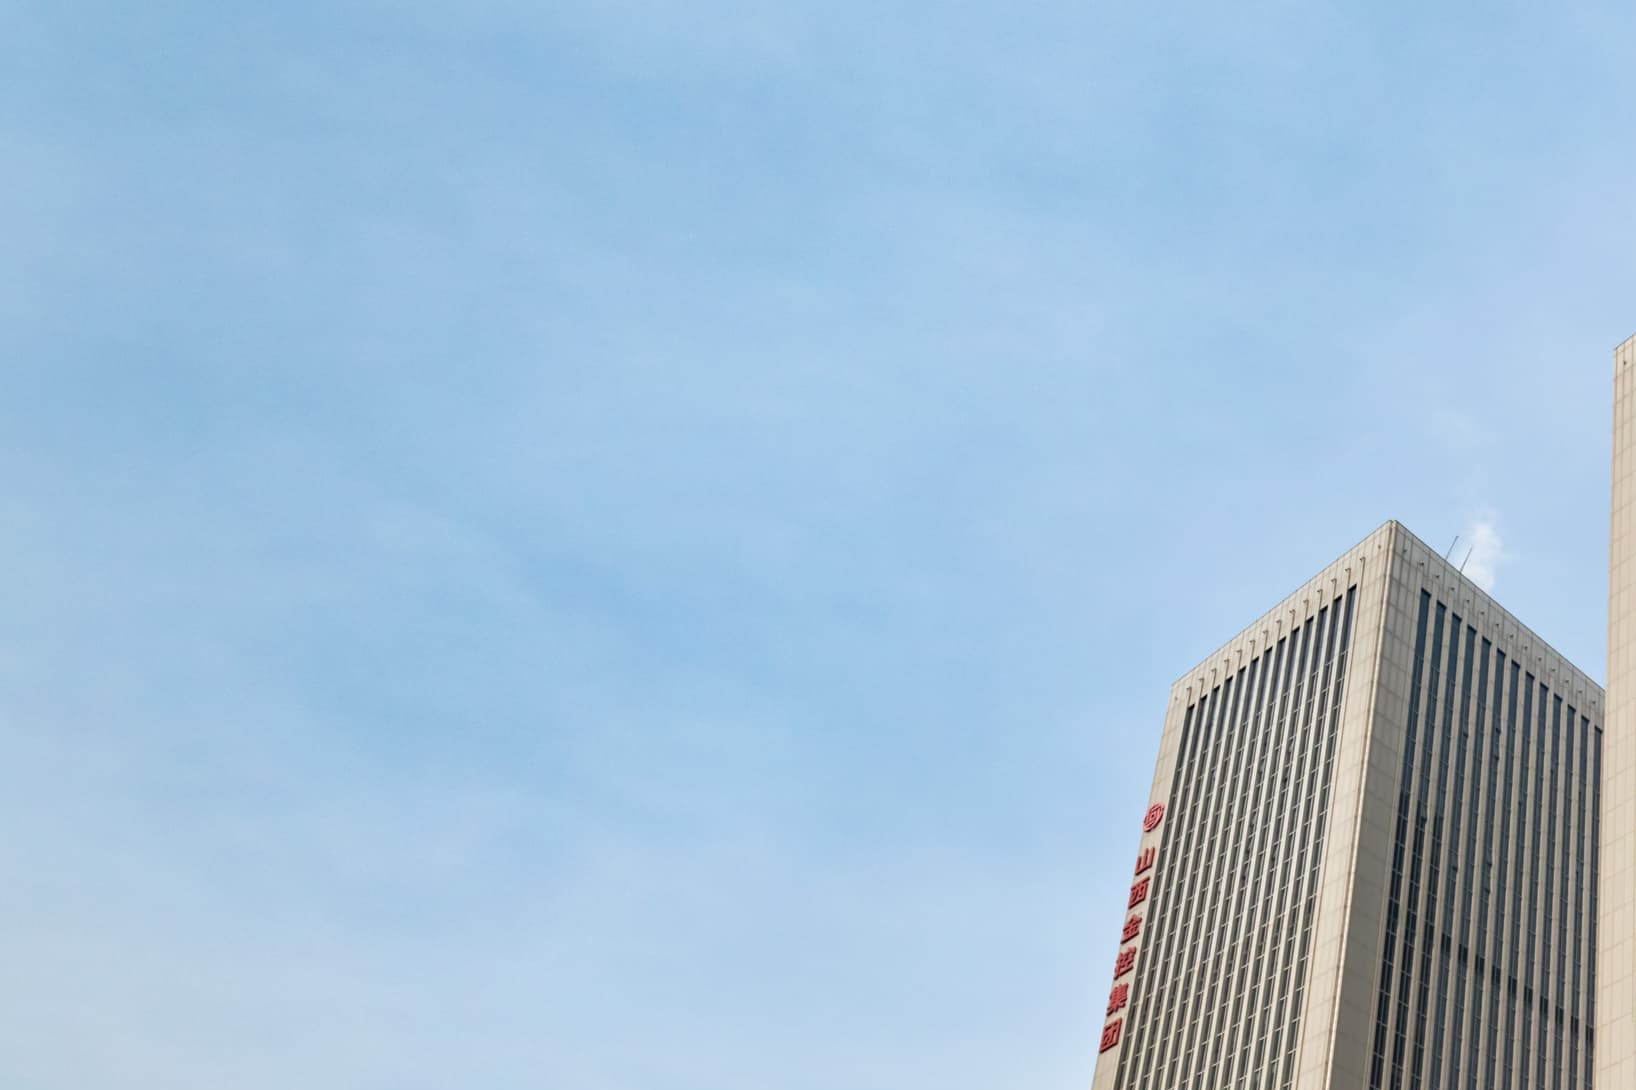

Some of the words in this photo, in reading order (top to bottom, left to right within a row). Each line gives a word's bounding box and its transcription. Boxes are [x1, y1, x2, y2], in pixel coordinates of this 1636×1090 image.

[1099, 847, 1155, 1054] 山西金控集团
